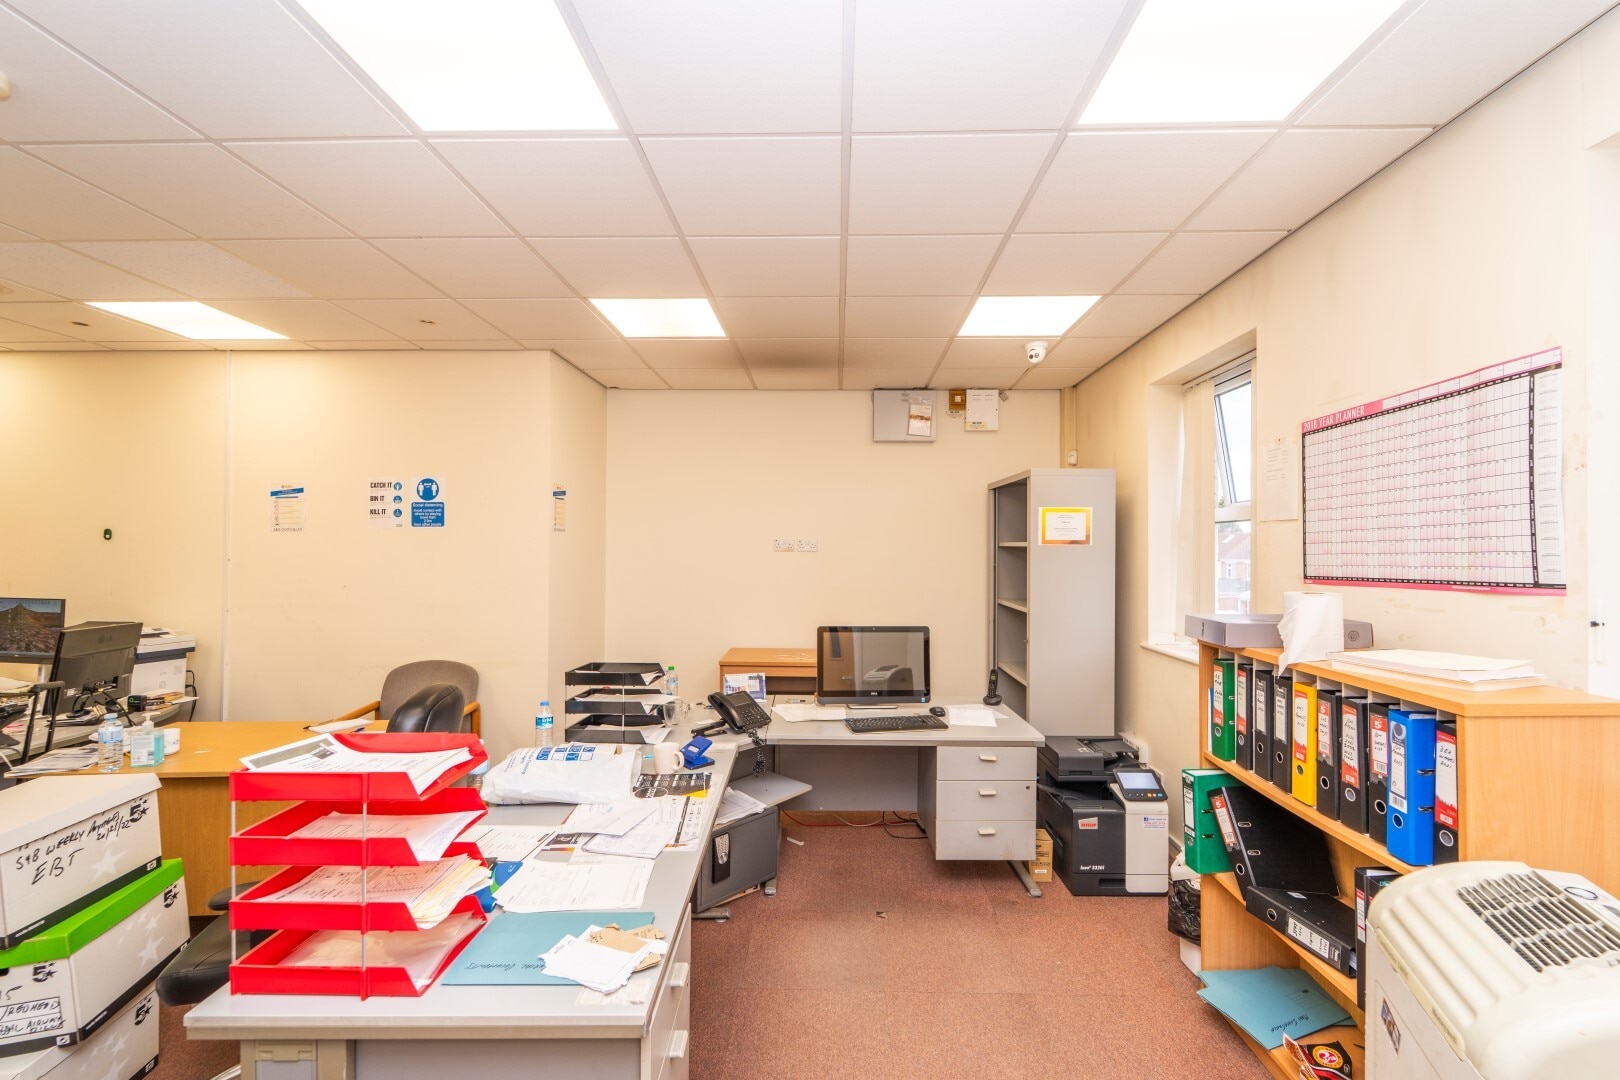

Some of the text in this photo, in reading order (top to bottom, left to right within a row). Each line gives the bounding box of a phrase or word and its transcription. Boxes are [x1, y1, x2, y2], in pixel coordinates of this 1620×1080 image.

[1319, 414, 1334, 427] YEAR
[1335, 405, 1365, 420] PLANNER
[32, 848, 84, 885] EBT
